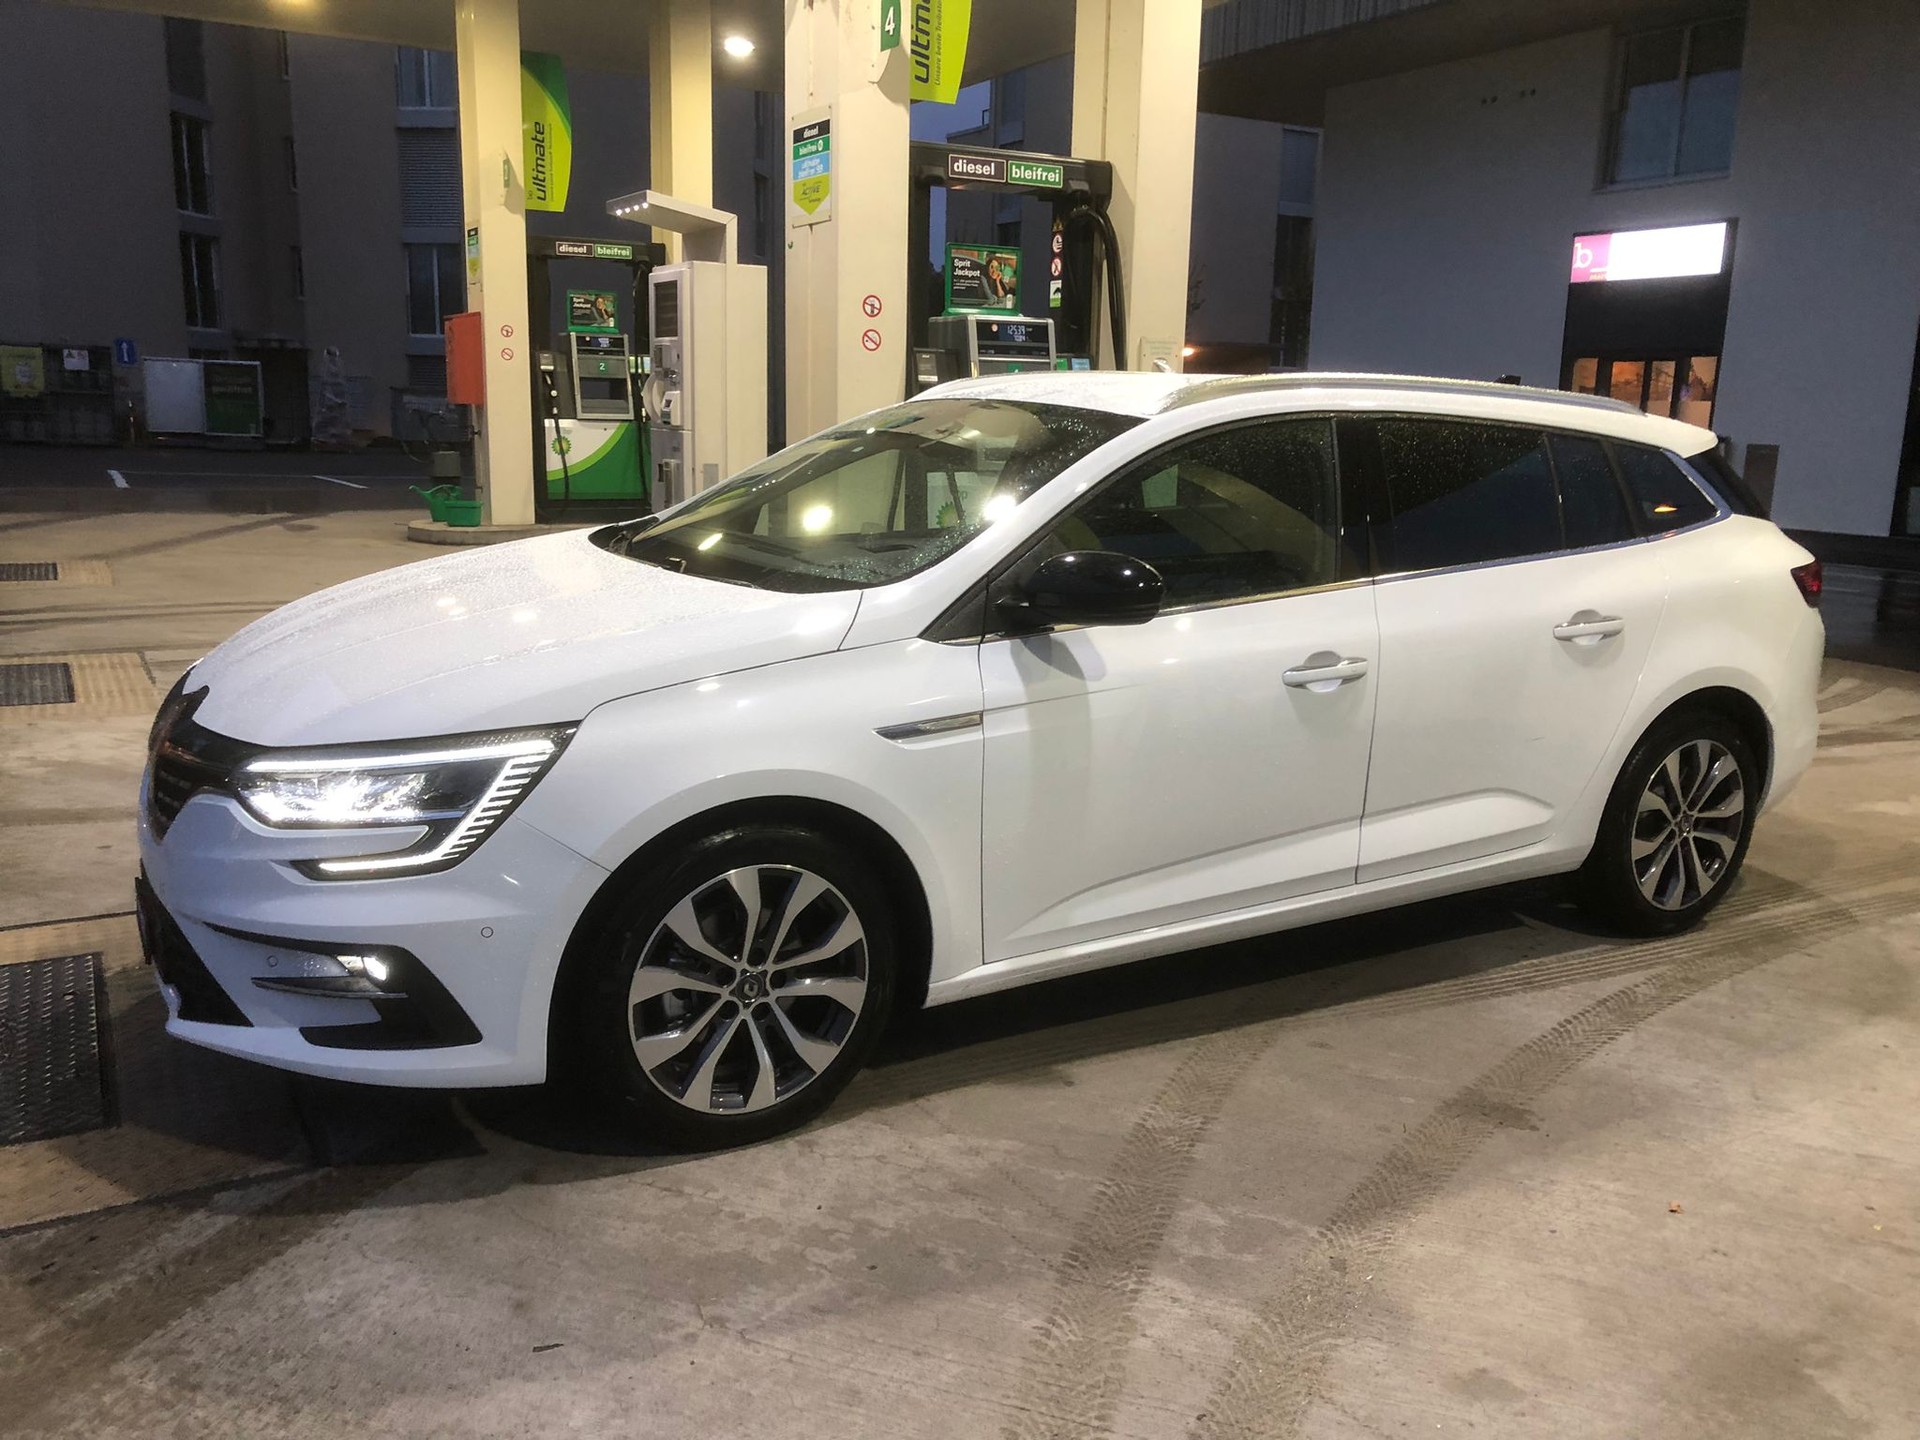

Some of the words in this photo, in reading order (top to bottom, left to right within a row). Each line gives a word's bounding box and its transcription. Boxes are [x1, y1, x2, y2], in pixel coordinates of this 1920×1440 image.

[884, 6, 896, 36] 4
[910, 0, 931, 84] ultim
[803, 125, 819, 139] diesel
[530, 121, 547, 201] ultimate
[953, 159, 996, 176] diesel
[1011, 165, 1060, 183] bleifrei
[558, 243, 588, 254] diesel
[597, 246, 631, 257] bleifrei
[953, 258, 971, 268] Sprit
[953, 267, 981, 278] Jackpot
[599, 362, 606, 371] 2
